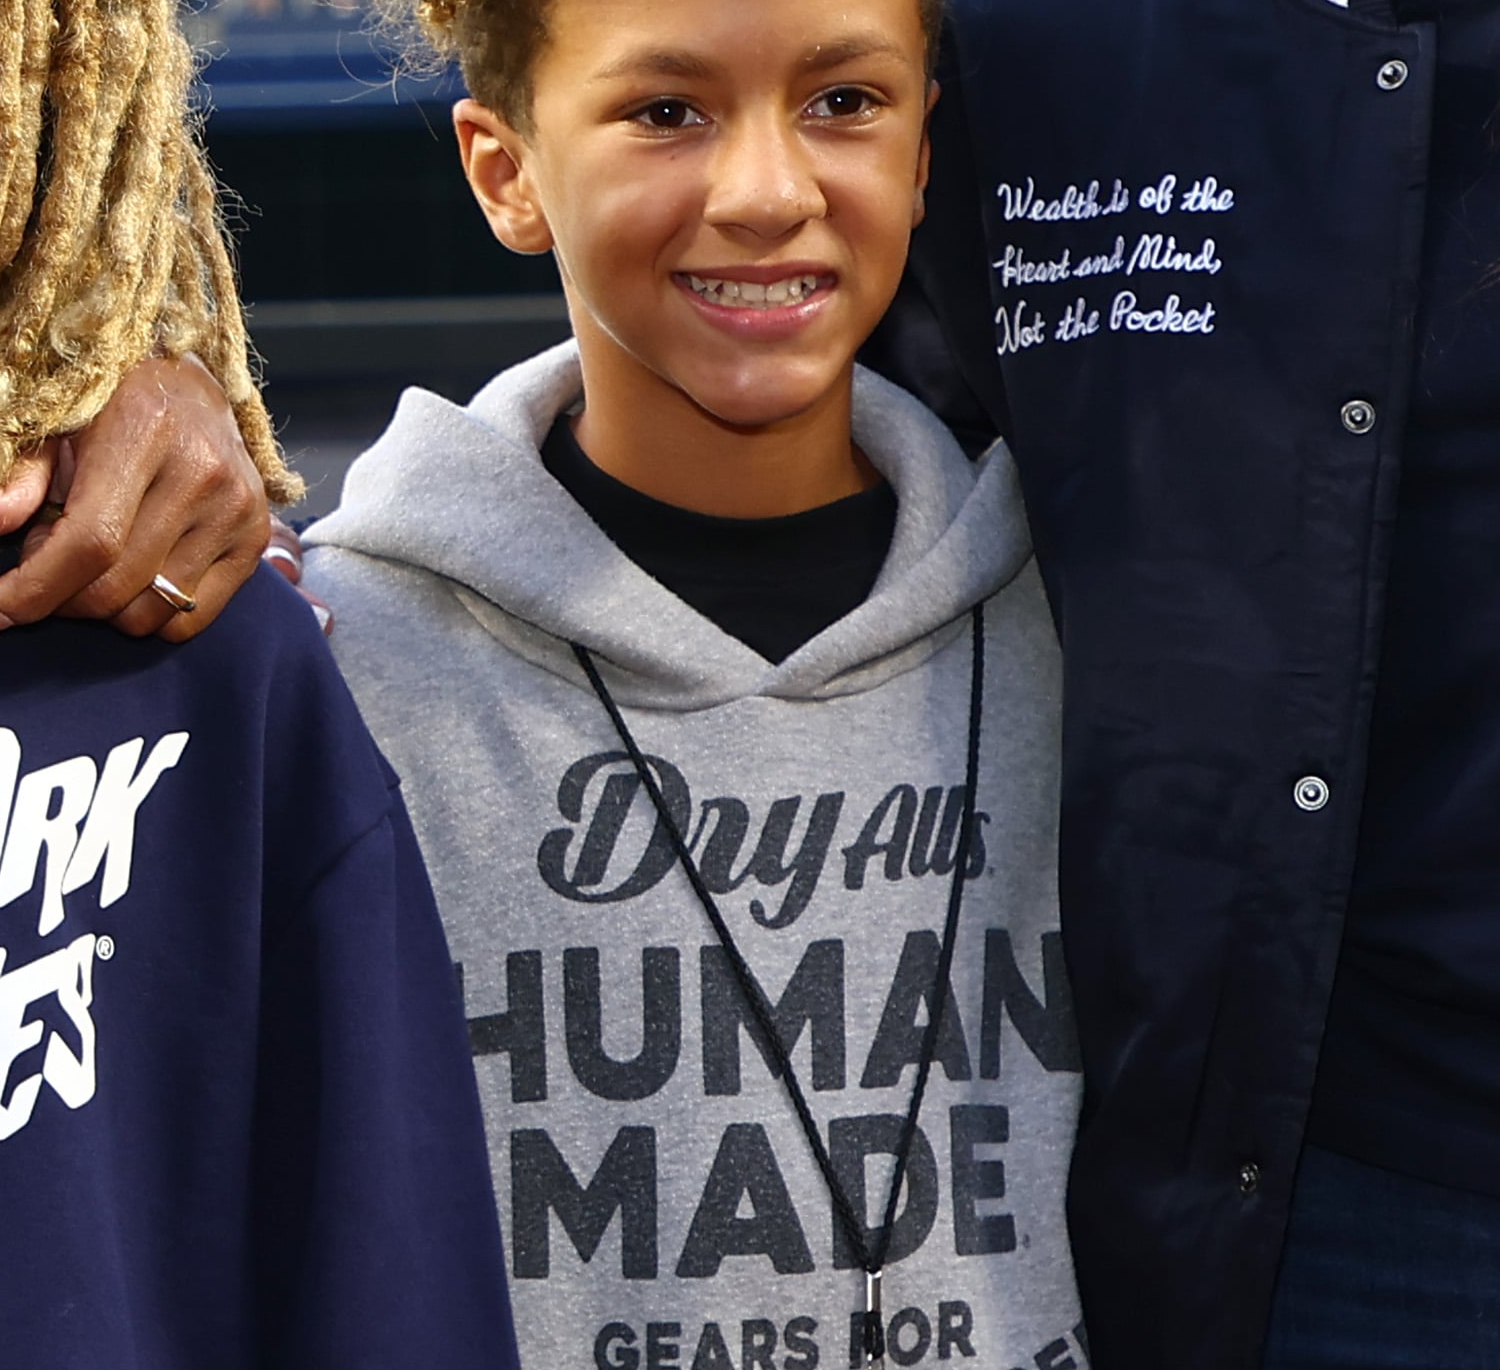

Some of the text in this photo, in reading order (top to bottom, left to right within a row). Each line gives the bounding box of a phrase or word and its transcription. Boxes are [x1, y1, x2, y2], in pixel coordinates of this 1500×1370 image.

[997, 174, 1234, 221] Wealth is of the
[993, 233, 1222, 288] Heart and Mind,
[995, 290, 1216, 355] Not the Pocket
[537, 751, 845, 930] Dry
[457, 929, 1084, 1103] HUMAN
[510, 1103, 1017, 1280] MADE
